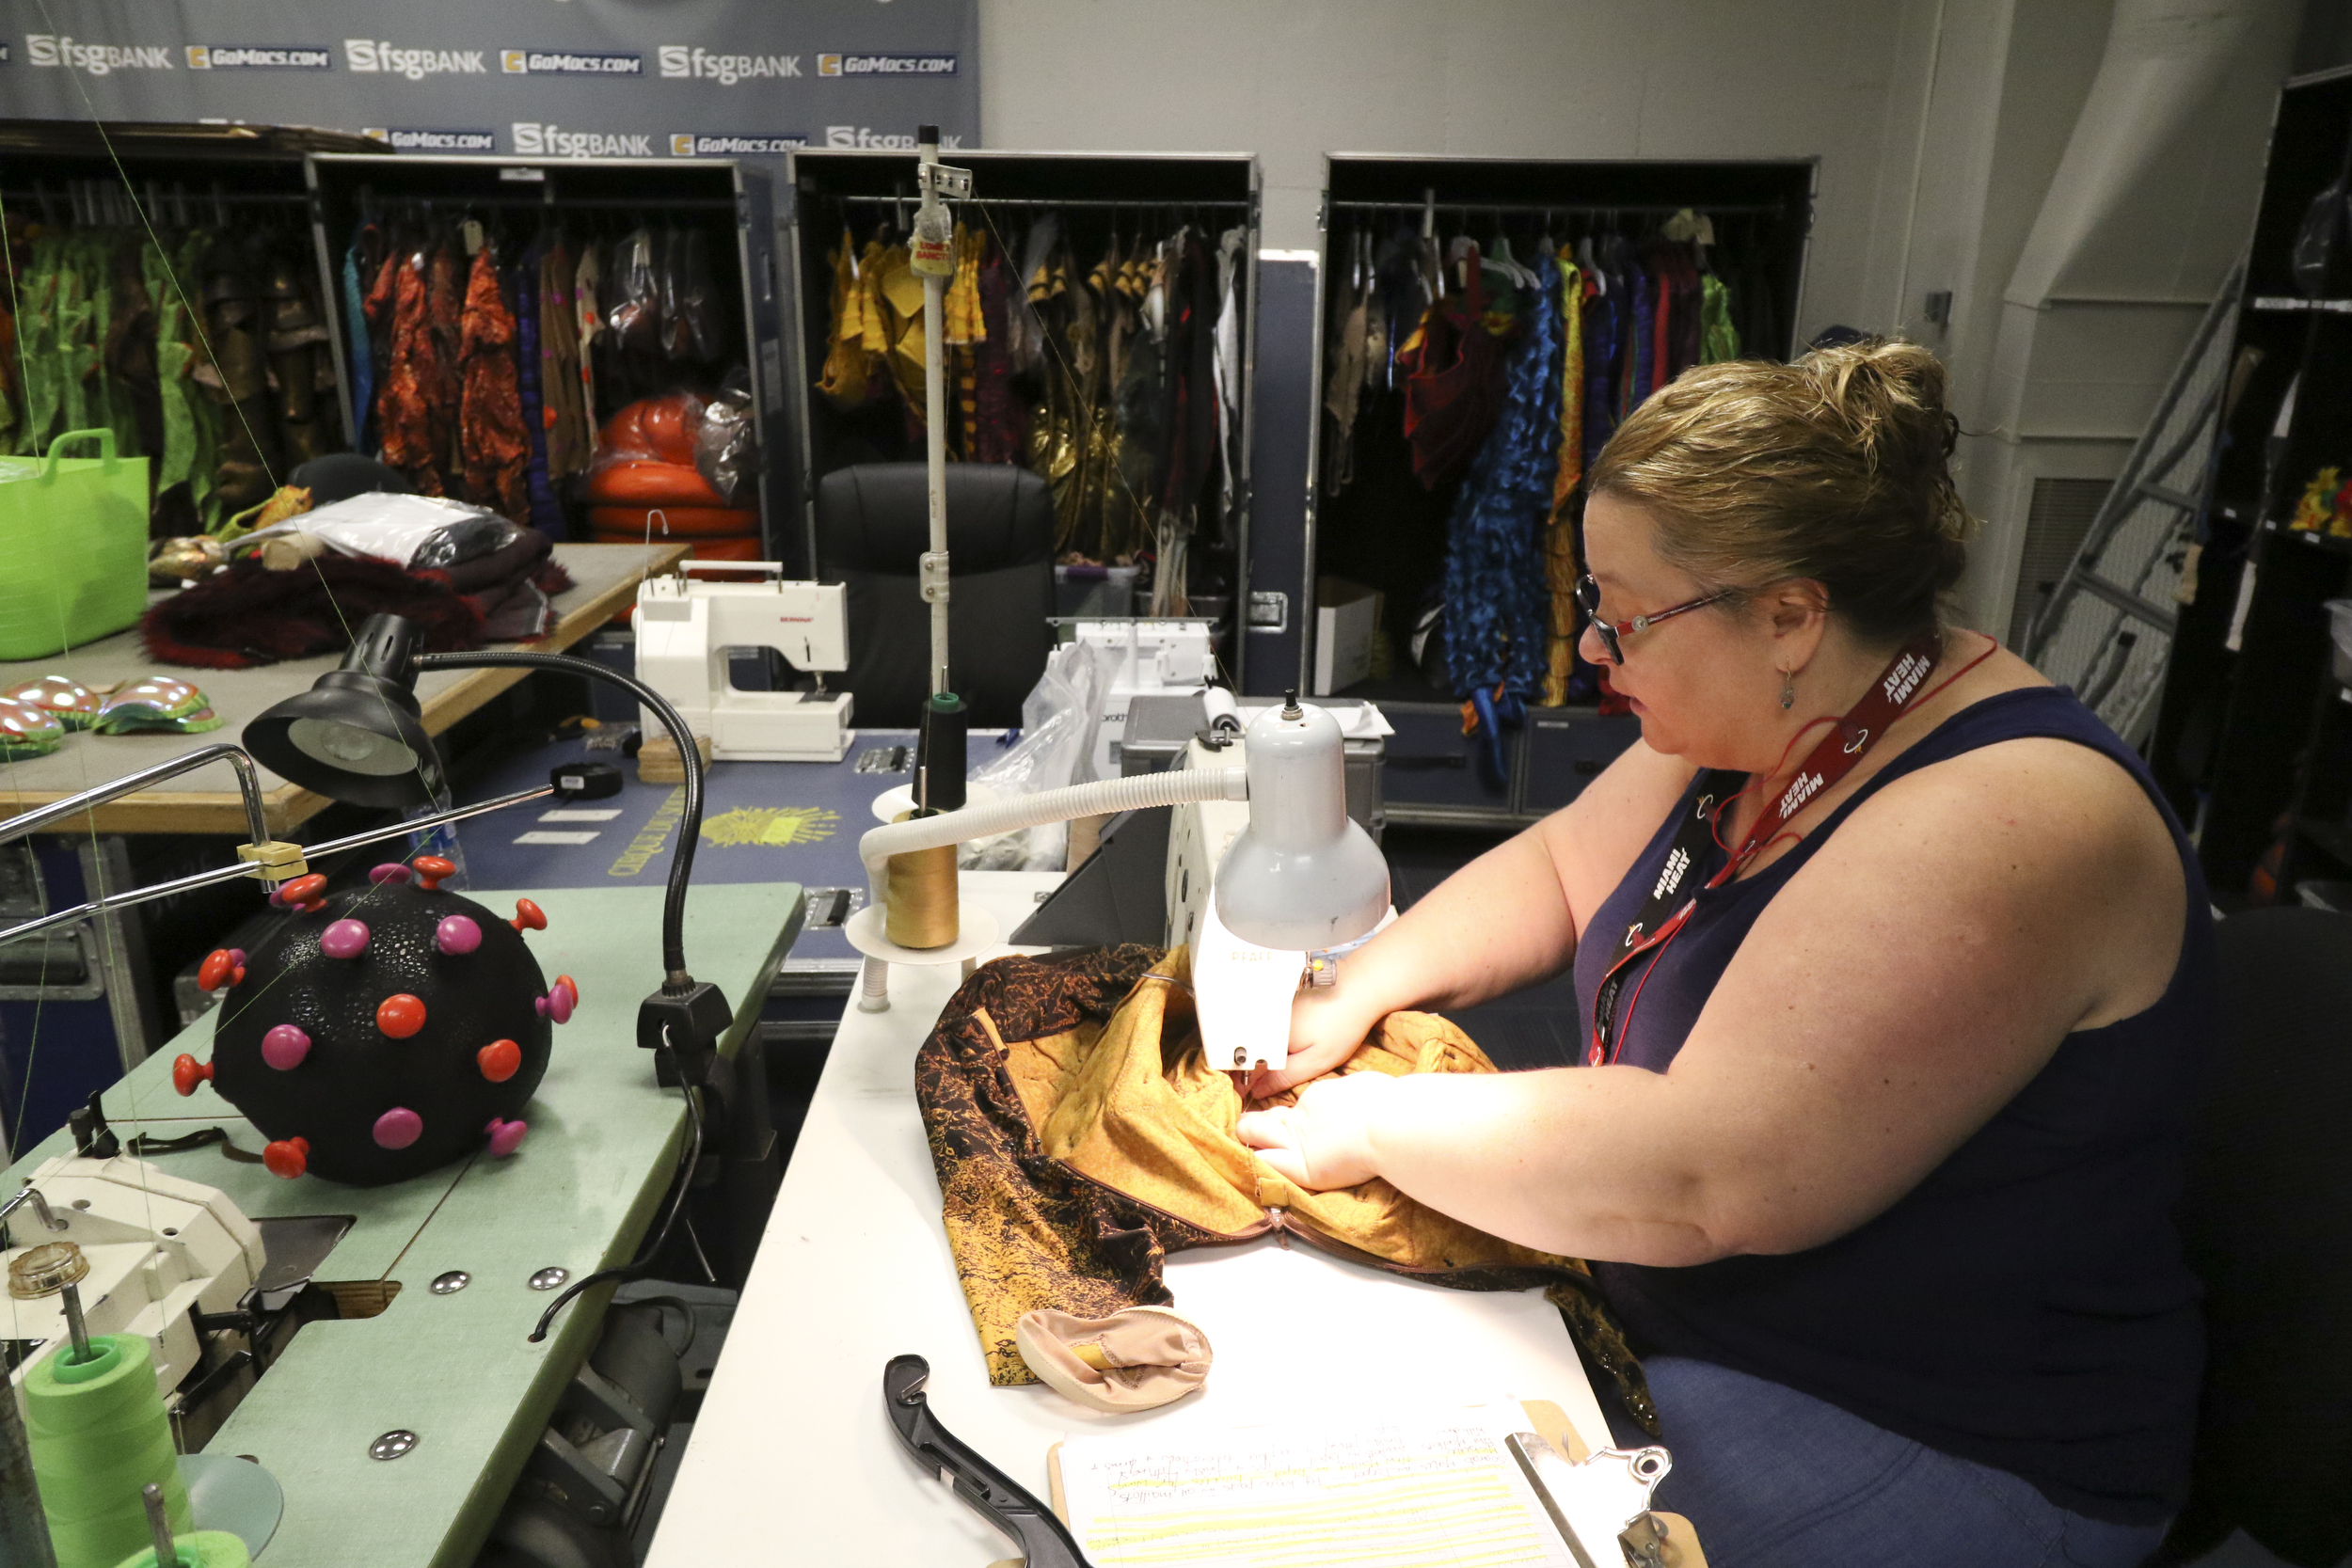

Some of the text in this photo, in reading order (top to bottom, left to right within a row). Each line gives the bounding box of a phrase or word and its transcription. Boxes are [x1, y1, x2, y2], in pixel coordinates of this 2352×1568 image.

[61, 37, 174, 74] fsgBANK
[377, 40, 485, 80] fsgBANK
[691, 48, 802, 85] fsgBANK
[544, 125, 652, 158] fsgBANK
[1883, 653, 1915, 703] HEAT
[1892, 654, 1931, 705] MIAMI
[1778, 771, 1809, 818] HEAT
[1783, 772, 1824, 820] MIAMI
[1653, 847, 1684, 901] MIAMI
[1666, 847, 1692, 896] HEAT
[1232, 951, 1273, 962] PFAFF
